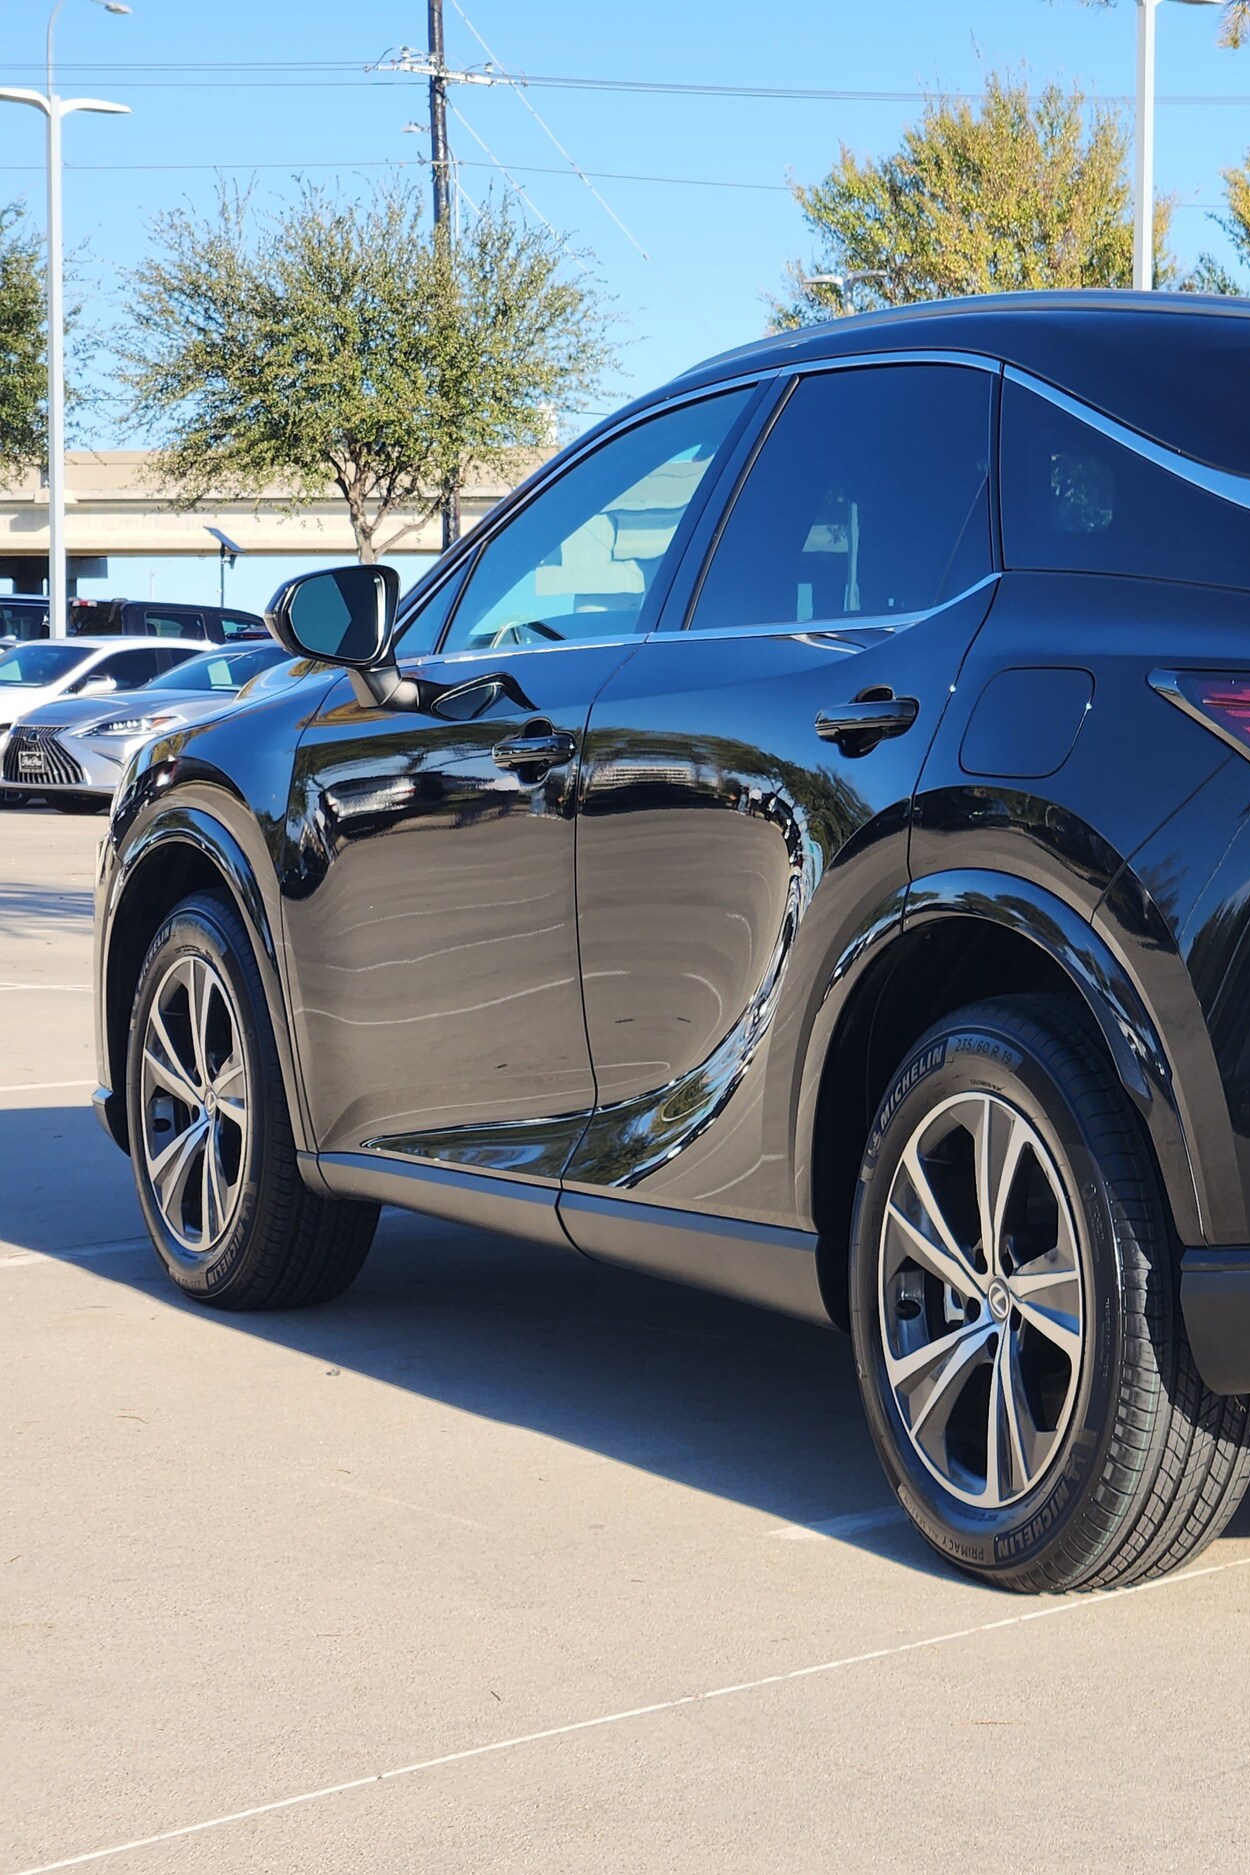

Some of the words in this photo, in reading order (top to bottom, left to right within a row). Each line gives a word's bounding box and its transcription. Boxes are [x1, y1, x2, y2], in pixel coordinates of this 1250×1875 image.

[954, 1038, 990, 1053] 235/60
[990, 1044, 1000, 1058] R
[1001, 1052, 1013, 1065] 19
[880, 1044, 944, 1130] MICHELIN
[207, 1222, 245, 1286] MICHELIN
[941, 1537, 985, 1561] PRIMACY
[998, 1477, 1071, 1559] MICHELIN
